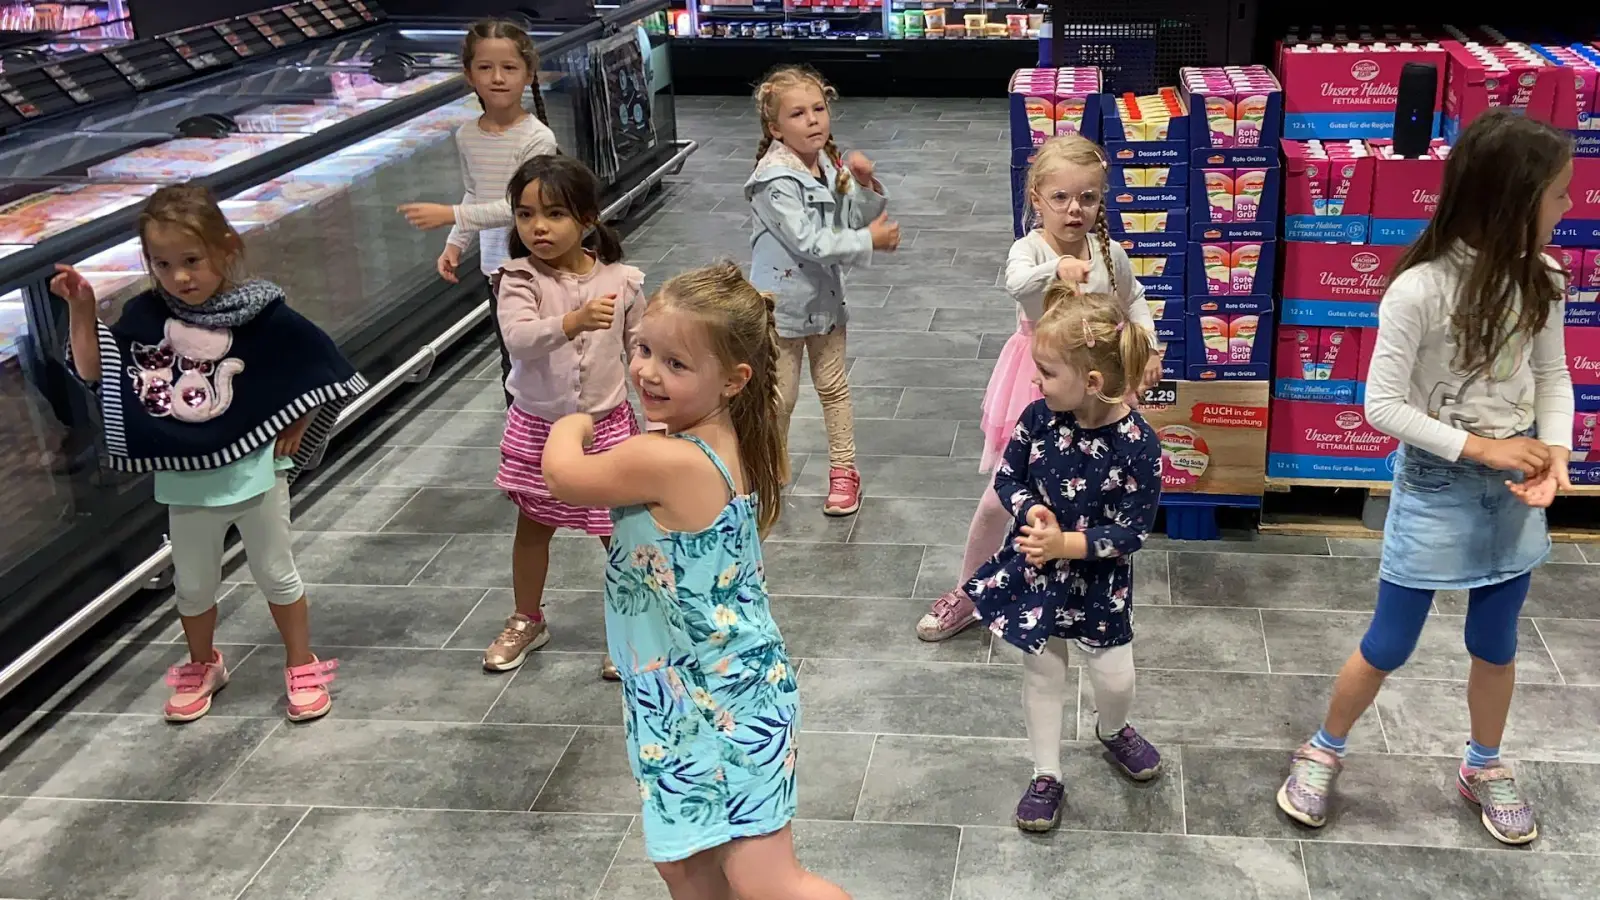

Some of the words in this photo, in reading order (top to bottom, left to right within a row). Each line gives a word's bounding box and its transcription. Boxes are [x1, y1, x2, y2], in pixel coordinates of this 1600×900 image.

[1320, 82, 1357, 96] Unsere
[1360, 82, 1398, 97] Haltba
[1332, 97, 1371, 105] FETTARME
[1238, 129, 1258, 137] Rote
[1238, 136, 1259, 144] Grüt
[1412, 189, 1440, 203] Unse
[1237, 203, 1257, 211] Rote
[1320, 271, 1358, 286] Unsere
[1332, 287, 1371, 295] FETTARME
[1573, 356, 1600, 370] Unse
[1144, 390, 1176, 402] 2.29
[1203, 406, 1233, 416] AUCH
[1243, 409, 1256, 417] der
[1203, 416, 1262, 427] Familienpackung
[1305, 428, 1342, 441] Unsere
[1344, 430, 1391, 444] Haltbare
[1316, 443, 1354, 451] FETTARME
[1356, 444, 1380, 452] MILCH
[1354, 465, 1376, 473] Region
[1161, 475, 1186, 485] rütze
